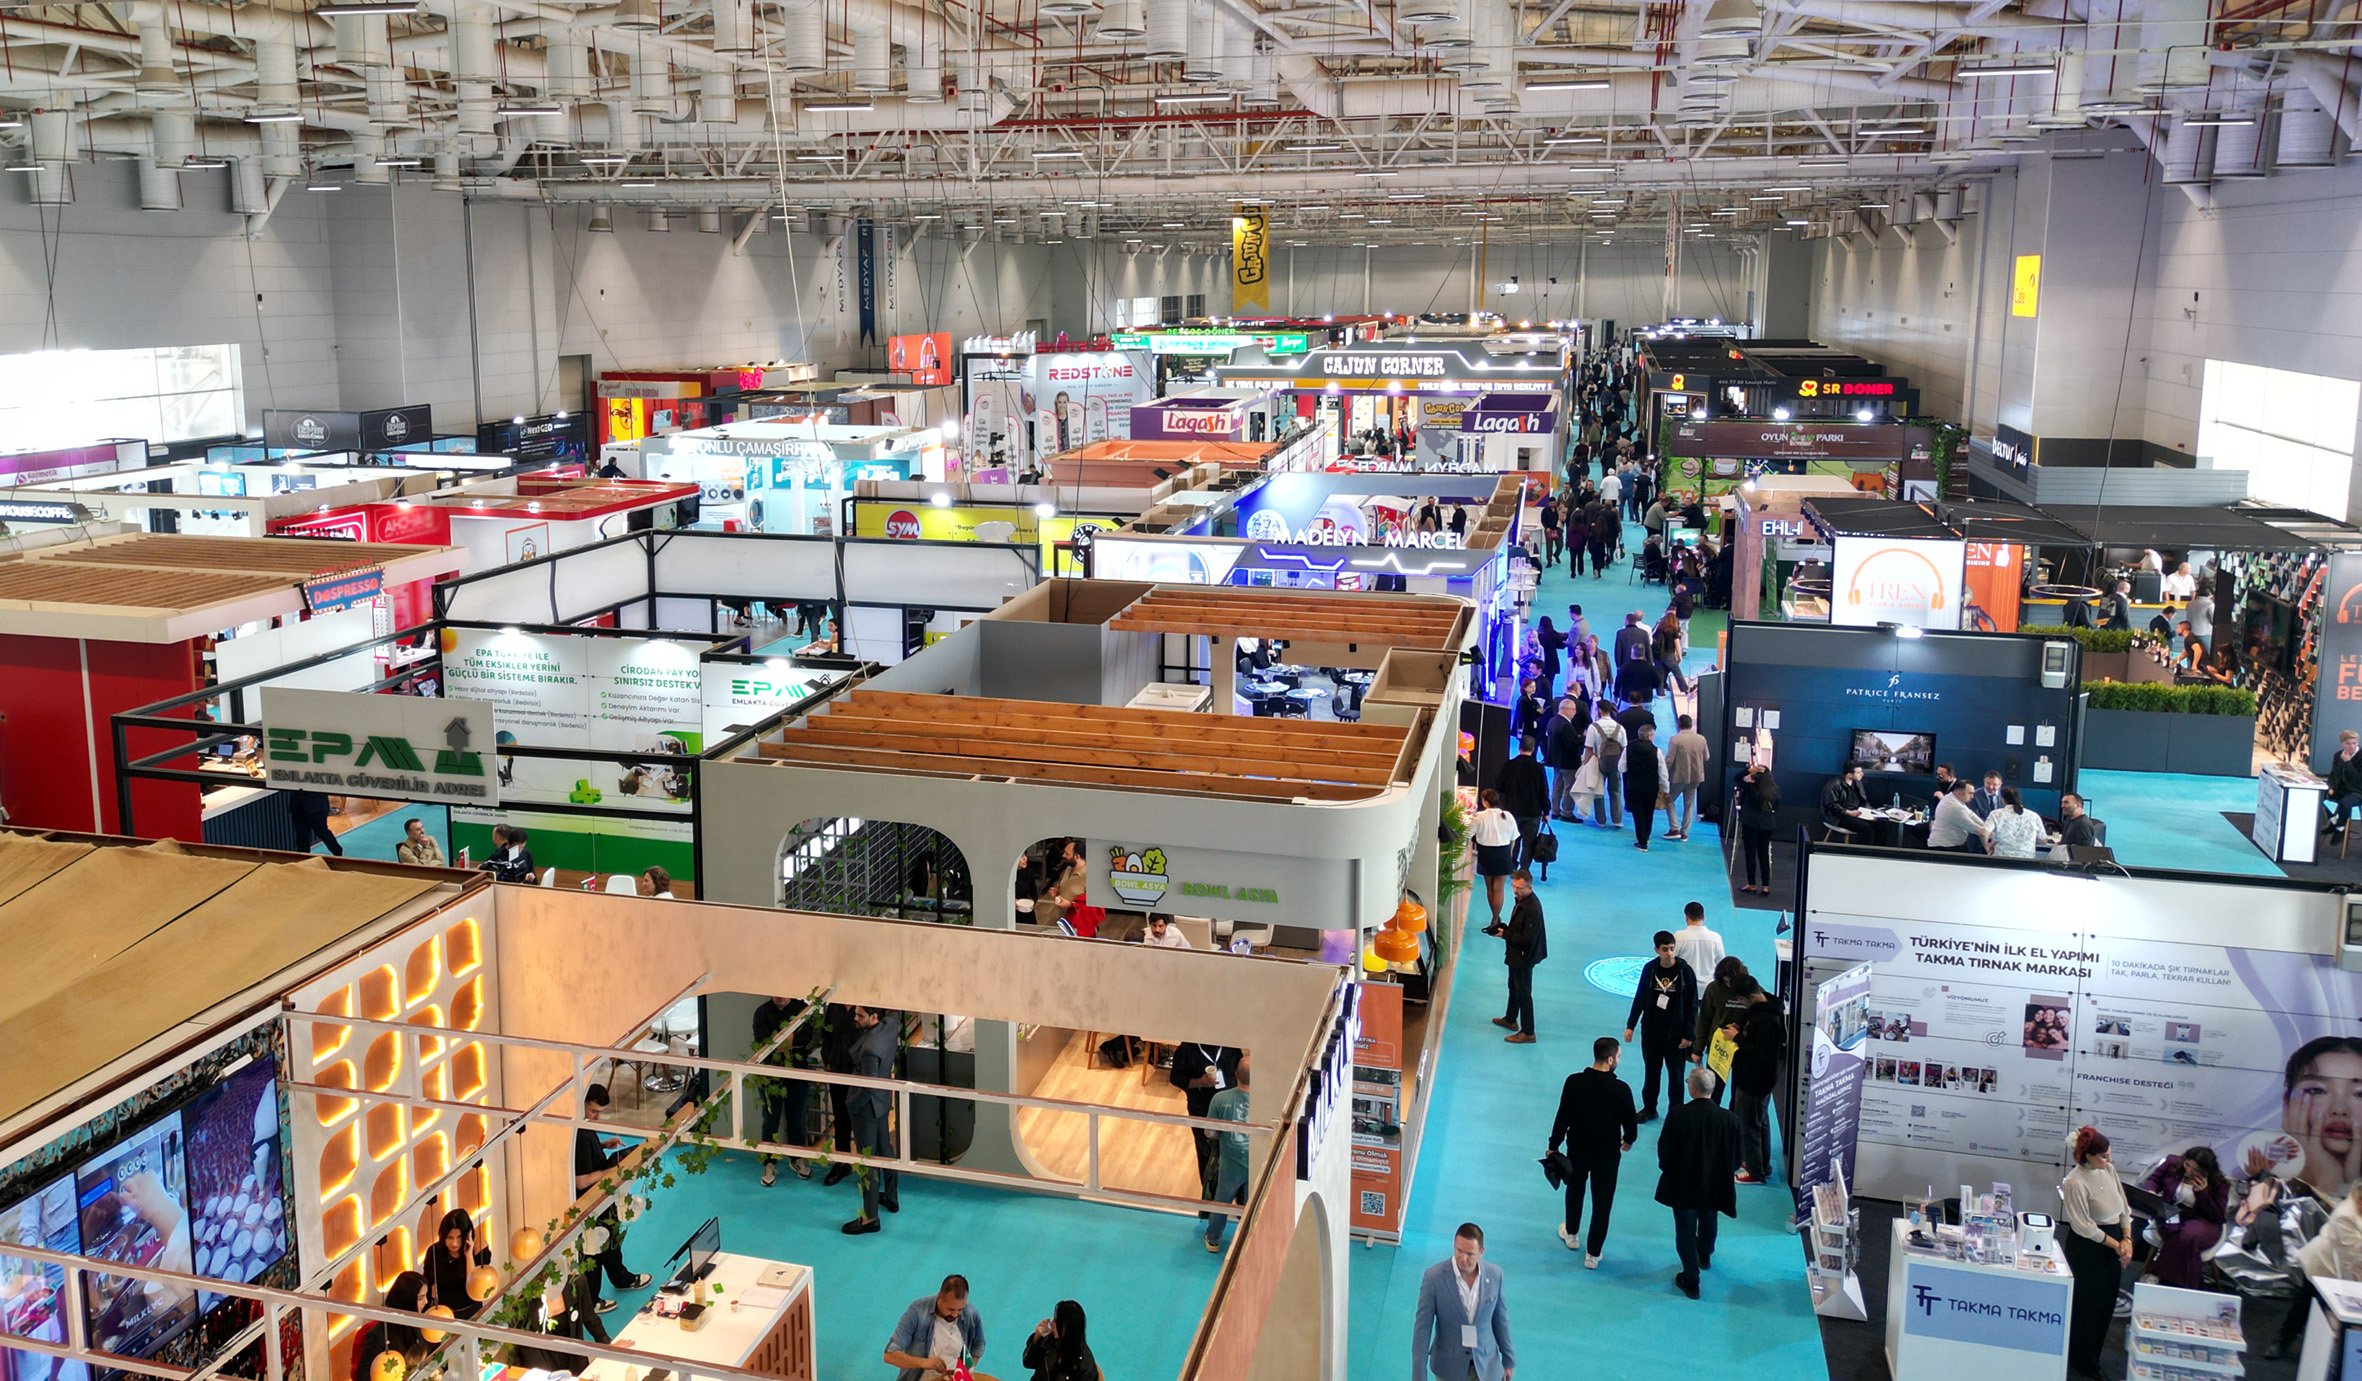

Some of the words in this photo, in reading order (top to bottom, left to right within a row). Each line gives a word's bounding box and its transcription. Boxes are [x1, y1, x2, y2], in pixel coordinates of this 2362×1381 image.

[1323, 357, 1377, 376] CAJUN
[1381, 357, 1446, 376] CORNER
[1823, 384, 1841, 395] SR
[1843, 383, 1894, 396] DONER
[1167, 413, 1226, 433] Lagash
[1474, 412, 1540, 434] Lagash
[1761, 433, 1789, 442] OYUN
[886, 520, 921, 539] SYM
[1383, 531, 1467, 550] MARCEL
[475, 648, 493, 658] EPA
[463, 657, 484, 668] TÜM
[448, 667, 479, 680] GÜÇLÜ
[480, 668, 496, 680] BİR
[497, 670, 536, 682] SİSTEME
[613, 676, 654, 688] SINIRSIZ
[655, 680, 693, 690] DESTEK
[1846, 688, 1889, 698] PATRICE
[1894, 689, 1941, 700] FRANSEZ
[271, 769, 342, 787] EMLAKTA
[346, 772, 430, 794] GÜVENİLİR
[433, 781, 487, 798] ADRES
[1114, 879, 1140, 889] BOWL
[1142, 881, 1166, 891] ASYA
[1183, 881, 1231, 900] BOWL
[1237, 887, 1279, 904] ASYA
[1833, 937, 1863, 947] TAKMA
[1865, 940, 1896, 950] TAKMA
[1909, 934, 2000, 955] TÜRKİYE'NİN
[2003, 942, 2028, 958] İLK
[2030, 947, 2048, 959] EL
[2050, 949, 2100, 964] YAPIMI
[1915, 952, 1965, 967] TAKMA
[1967, 957, 2023, 973] TIRNAK
[2025, 962, 2092, 979] MARKASI
[2111, 959, 2121, 968] 10
[2122, 960, 2166, 972] DAKİKADA
[2183, 965, 2230, 977] TIRNAKLAR
[2162, 973, 2195, 984] TEKRAR
[2076, 1072, 2131, 1086] FRANCHISE
[1948, 1298, 2002, 1318] TAKMA
[2007, 1306, 2062, 1326] TAKMA
